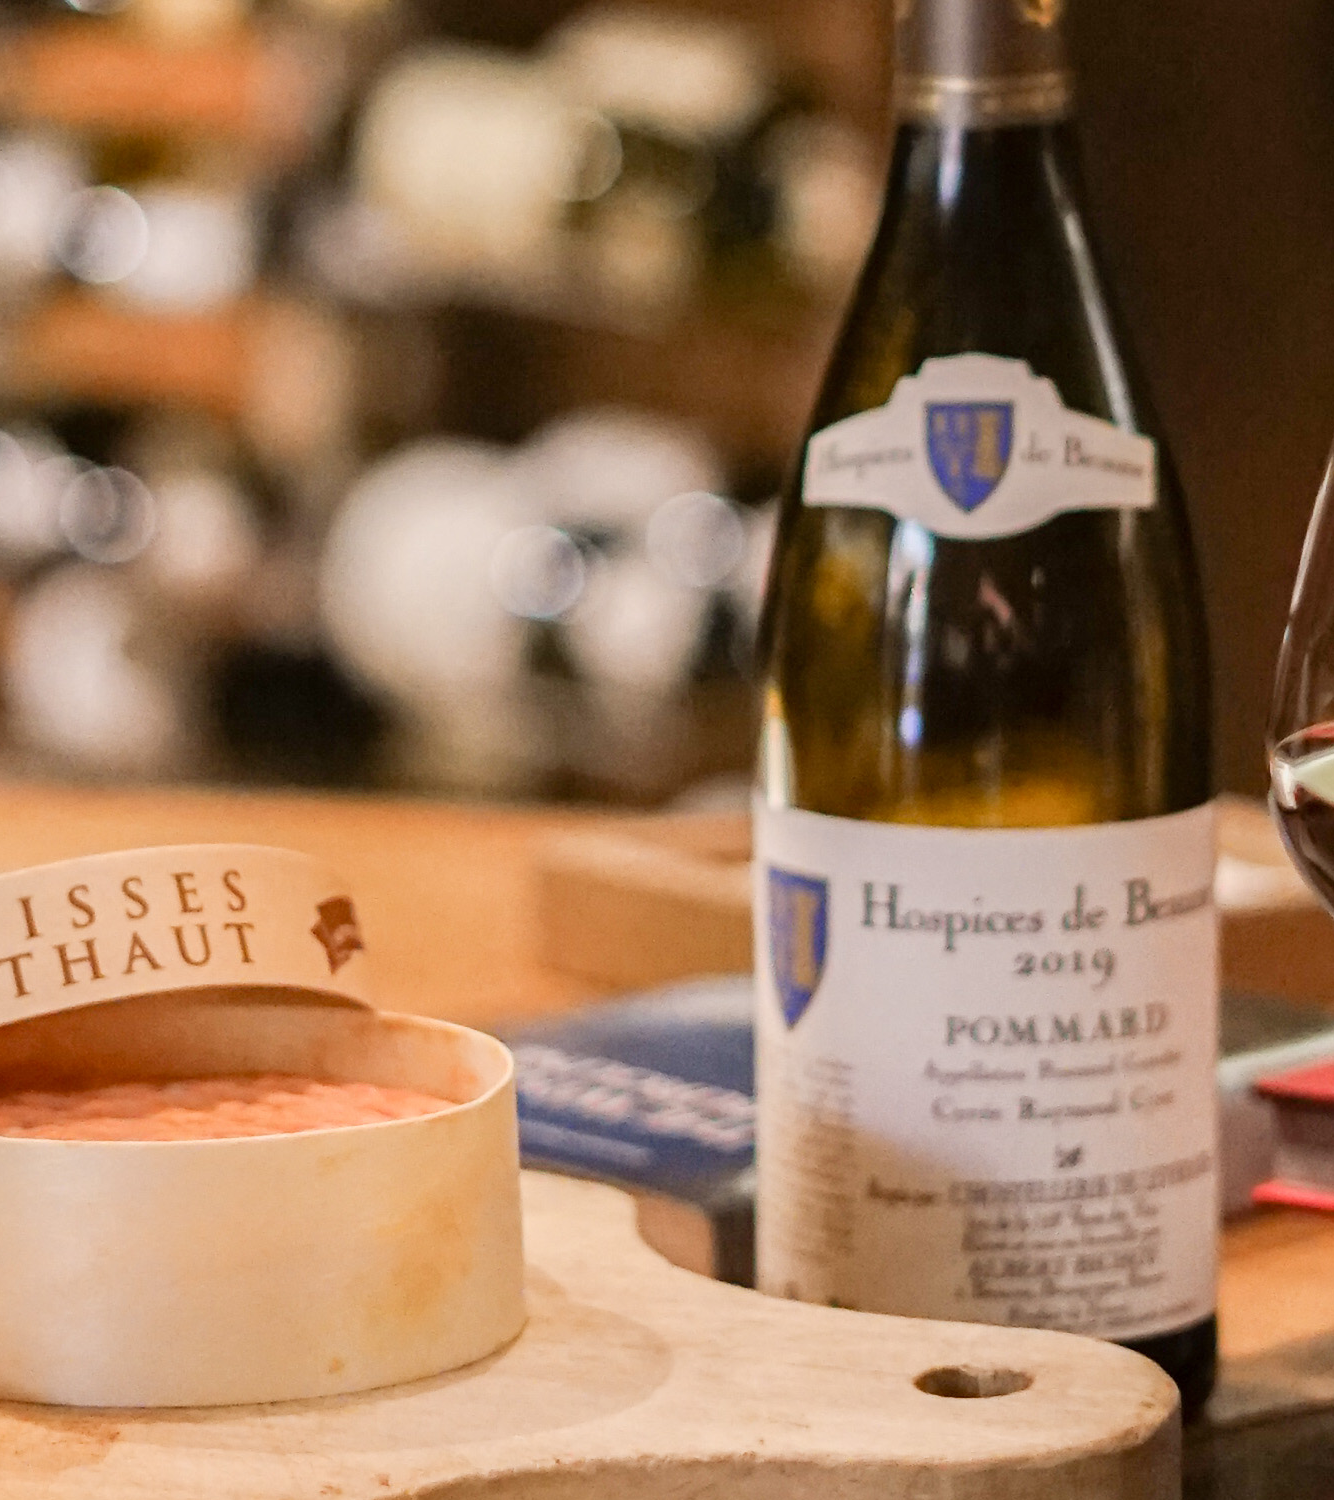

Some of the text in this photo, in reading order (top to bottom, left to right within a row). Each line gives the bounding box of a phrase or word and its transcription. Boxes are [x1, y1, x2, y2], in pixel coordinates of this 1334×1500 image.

[860, 880, 1044, 953] Hospices
[1060, 882, 1109, 933] de
[1012, 947, 1117, 991] 2019
[944, 1001, 1171, 1048] POMMARD
